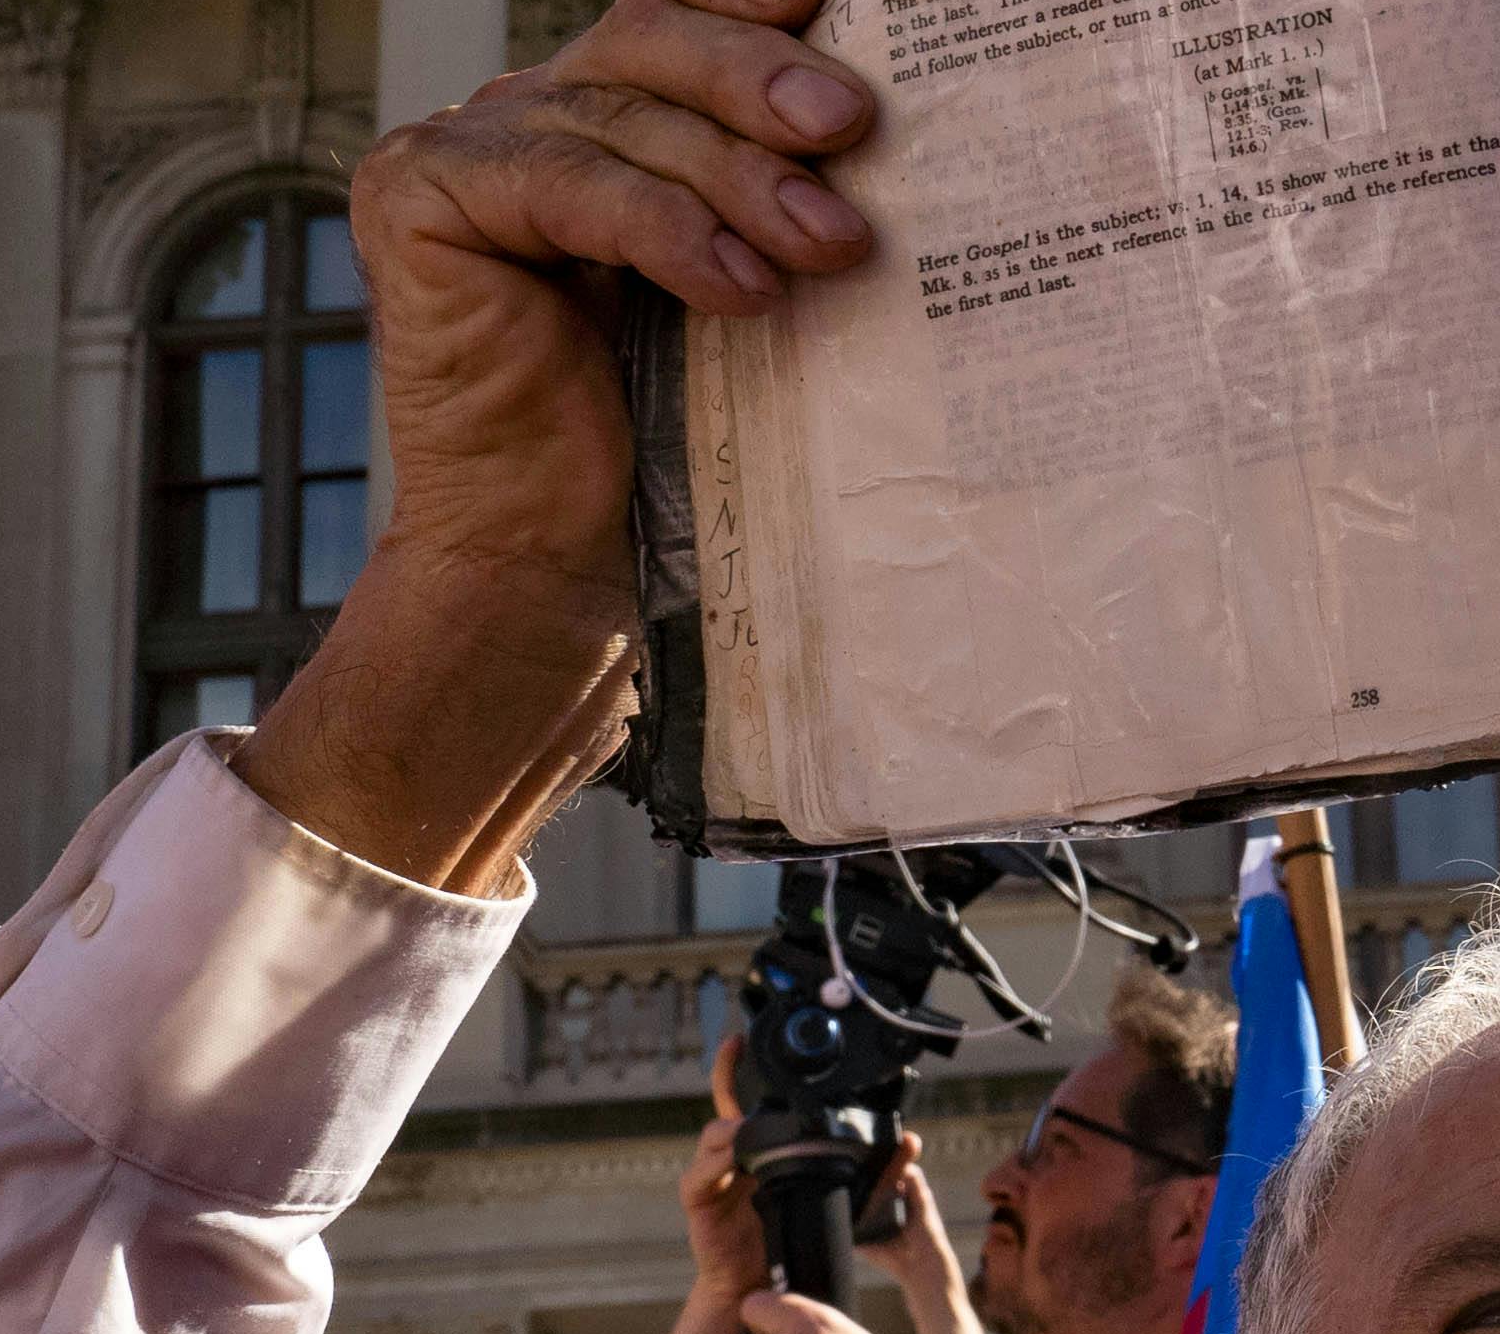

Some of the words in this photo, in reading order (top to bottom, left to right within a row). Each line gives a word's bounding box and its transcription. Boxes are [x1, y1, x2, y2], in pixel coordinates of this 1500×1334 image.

[886, 23, 904, 37] to
[910, 13, 937, 30] the
[943, 3, 979, 23] last.
[1172, 7, 1333, 58] ILLUSTRATION
[892, 61, 922, 84] and
[927, 52, 978, 75] follow
[984, 43, 1012, 60] the
[1016, 25, 1083, 53] subject,
[1088, 19, 1106, 34] or
[1112, 10, 1152, 28] turn
[1194, 64, 1220, 85] (at
[1225, 51, 1274, 75] Mark
[1304, 38, 1324, 58] 1.)
[917, 254, 959, 273] Here
[966, 232, 1030, 262] Gospel
[1035, 229, 1050, 246] is
[1056, 223, 1085, 241] the
[1090, 206, 1160, 233] subject;
[1197, 193, 1213, 209] 1,
[1221, 185, 1248, 204] 14,
[1256, 178, 1274, 197] 15
[1281, 171, 1327, 192] show
[1333, 158, 1389, 179] where
[1395, 151, 1411, 167] it
[1418, 146, 1434, 163] is
[1442, 141, 1462, 158] at
[925, 302, 953, 320] the
[958, 292, 994, 312] first
[999, 281, 1032, 303] and
[1037, 274, 1076, 294] last.
[1350, 688, 1381, 710] 258
